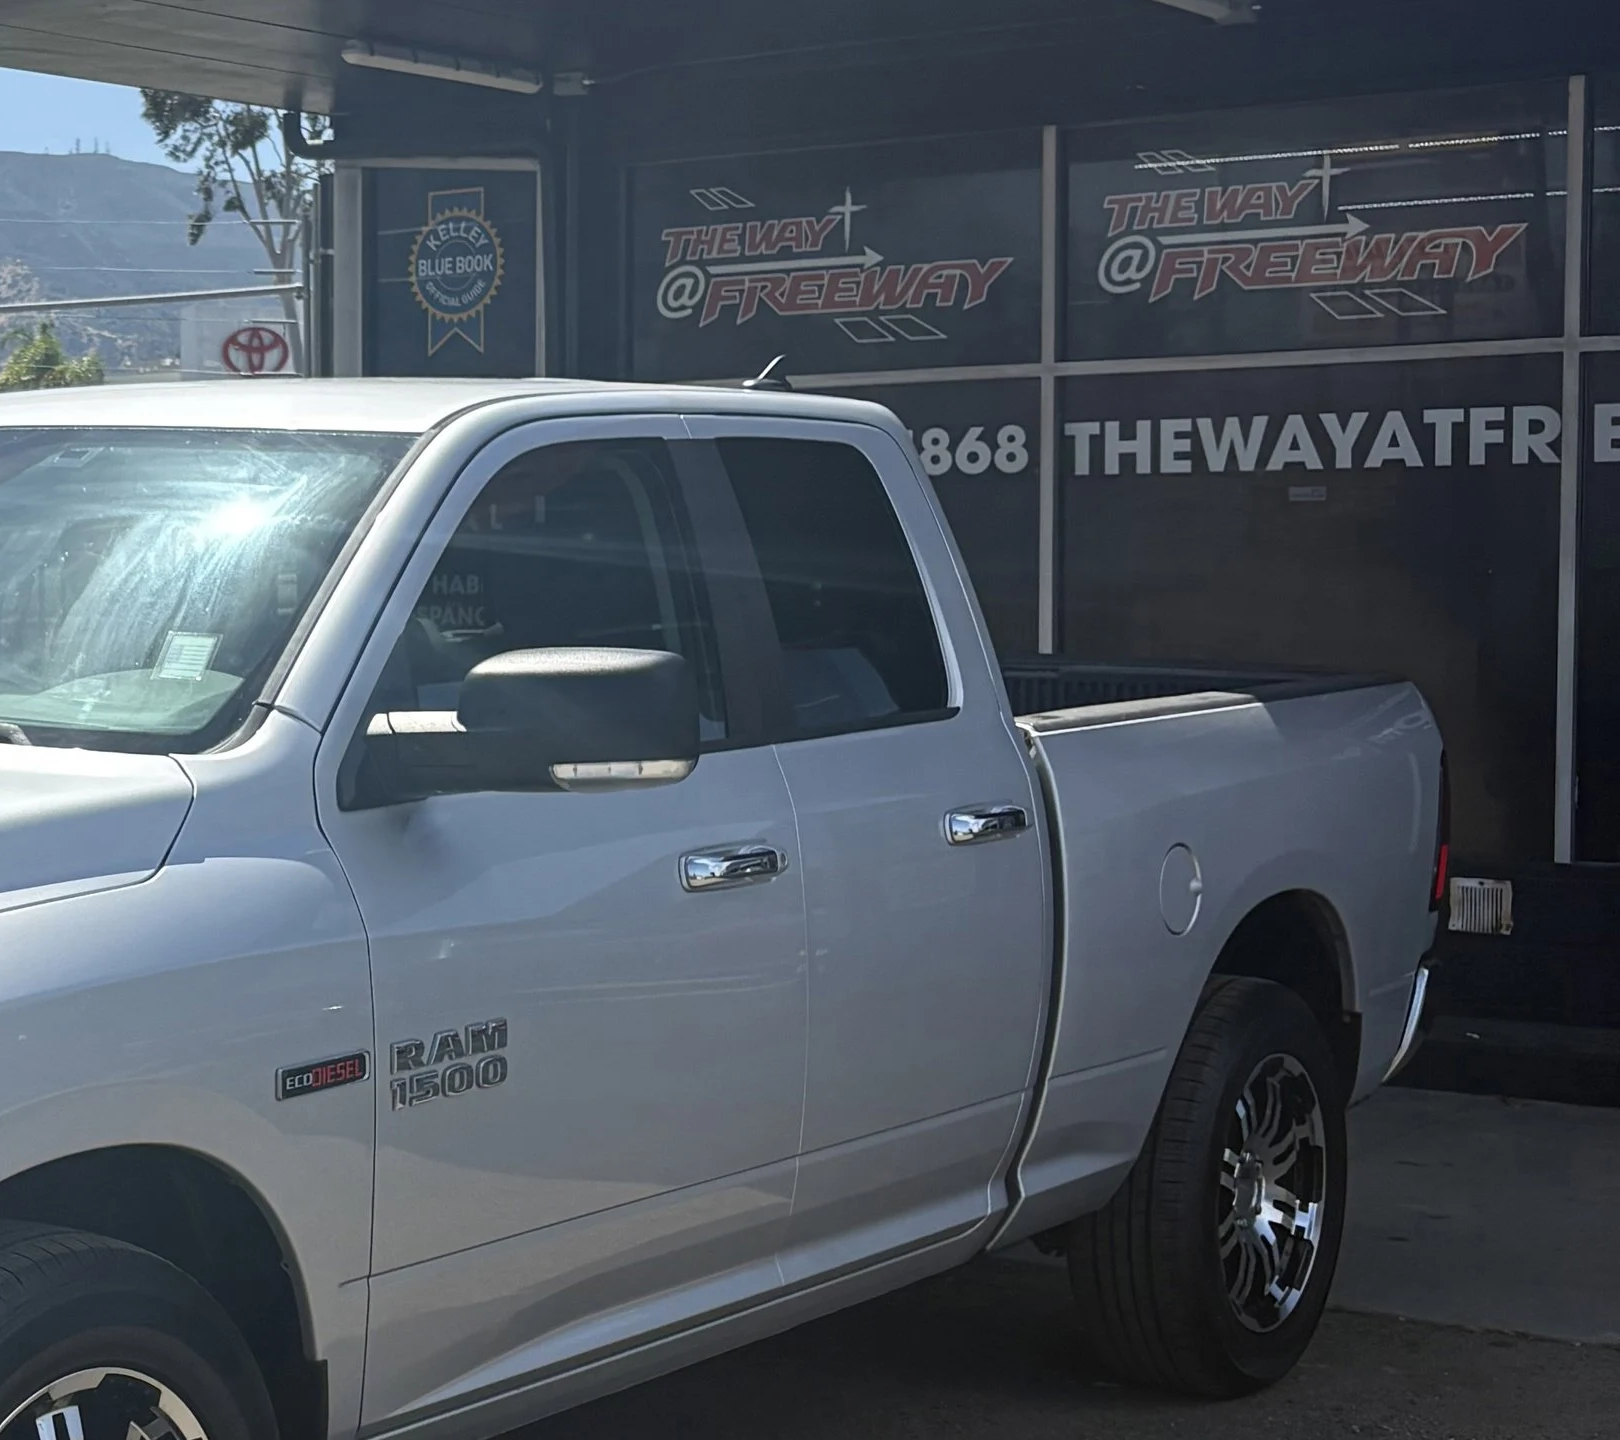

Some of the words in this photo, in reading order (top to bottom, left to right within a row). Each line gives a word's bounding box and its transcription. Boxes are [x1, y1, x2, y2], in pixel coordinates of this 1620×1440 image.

[1104, 189, 1200, 237] THE
[1203, 179, 1320, 224] WAY
[426, 221, 489, 252] KELLEY
[662, 224, 742, 267] THE
[746, 215, 841, 256] WAY
[418, 258, 453, 277] BLUE
[456, 254, 494, 274] BOOK
[426, 280, 461, 307] OFFICIAL
[461, 279, 487, 305] GUIDE
[901, 424, 1029, 477] 868
[432, 574, 484, 595] HAB
[389, 1017, 508, 1075] RAM
[285, 1059, 363, 1091] ECODIESEL
[389, 1054, 508, 1111] 1500
